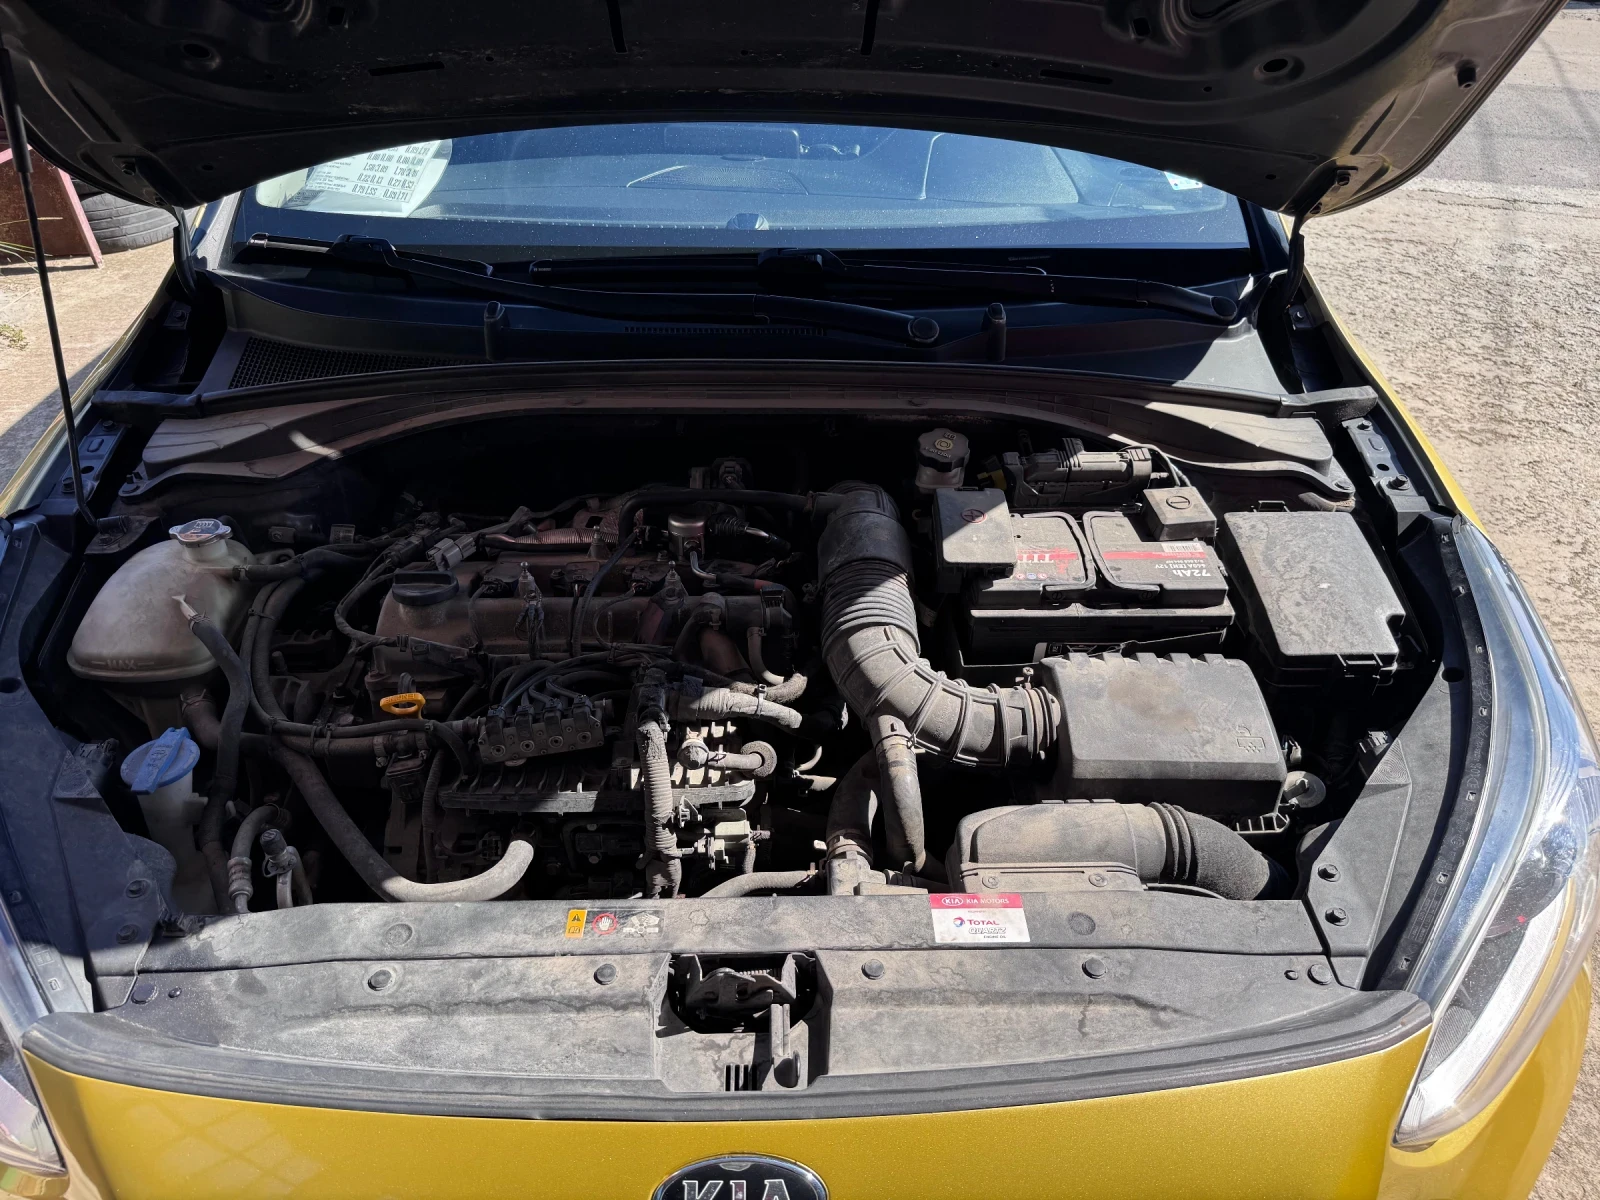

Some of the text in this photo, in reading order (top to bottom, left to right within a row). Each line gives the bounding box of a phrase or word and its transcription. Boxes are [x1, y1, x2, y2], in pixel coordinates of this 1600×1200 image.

[1172, 569, 1211, 577] 72Ah
[106, 659, 137, 670] MAX
[969, 927, 1006, 935] QUARTZ
